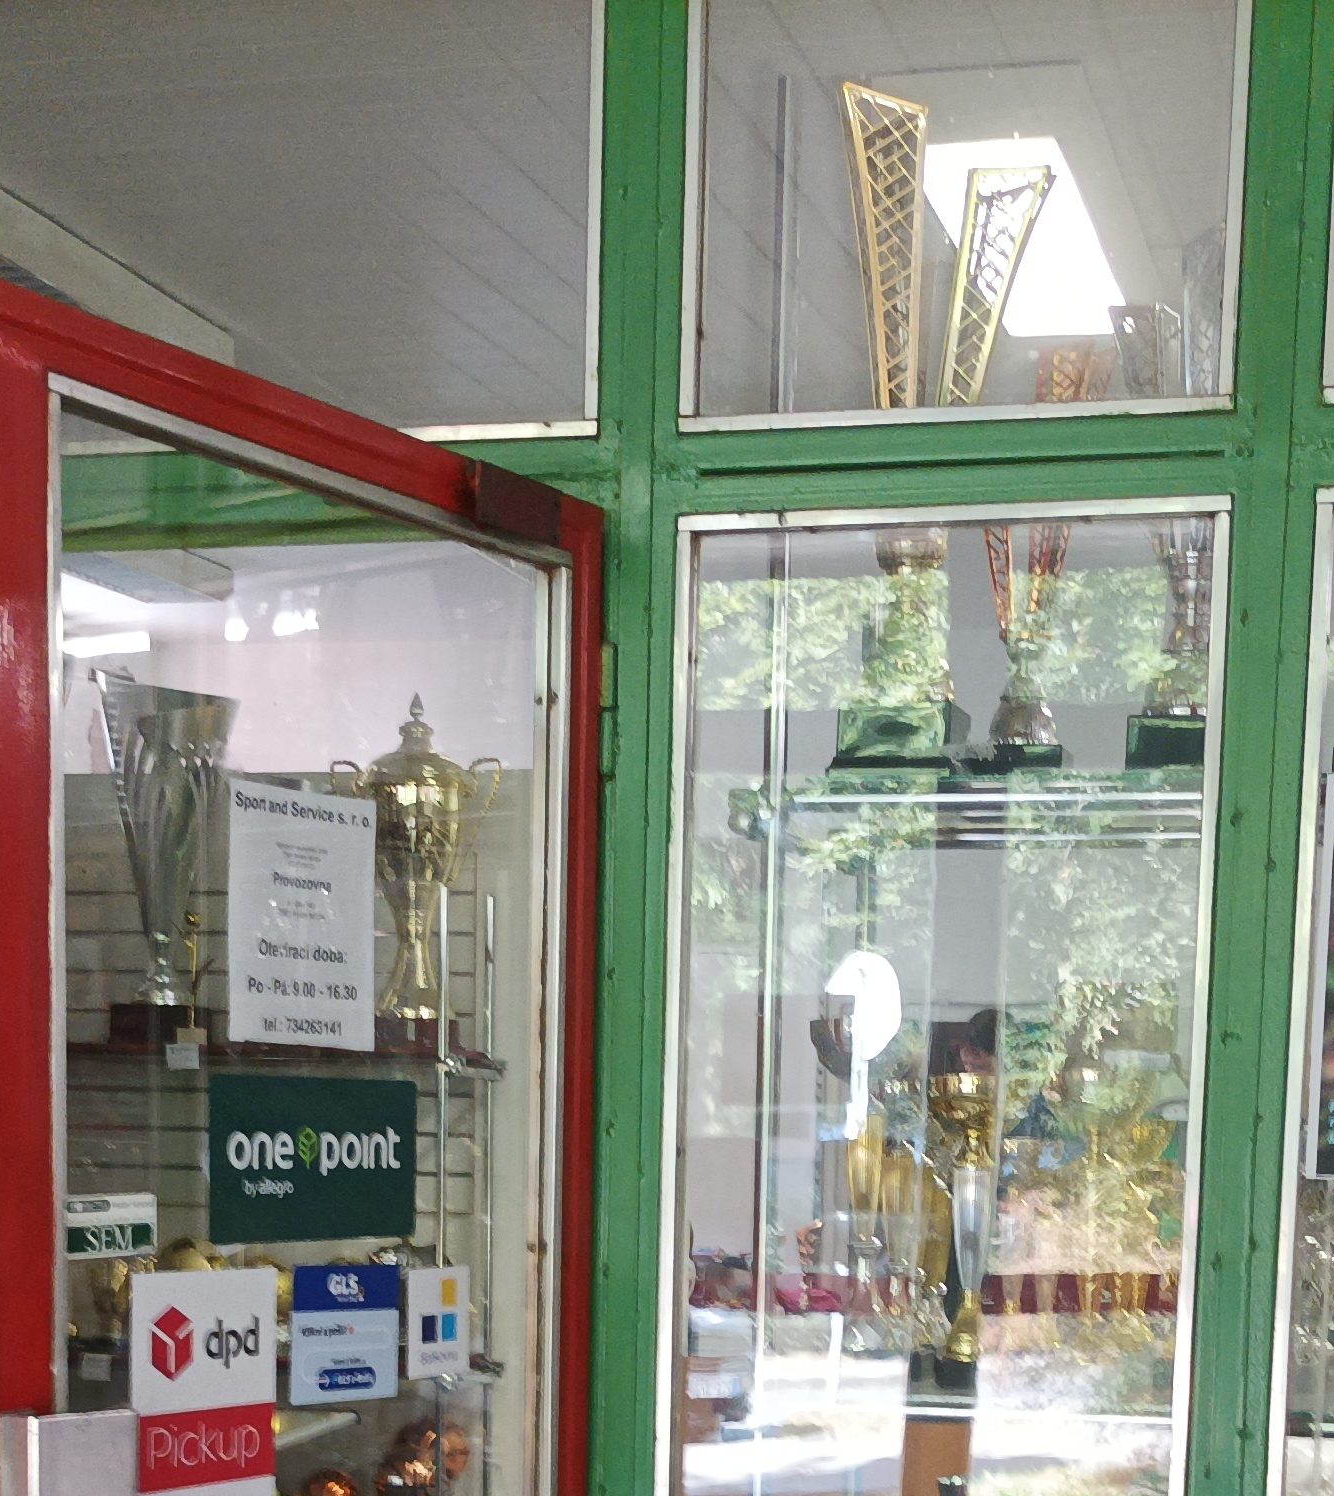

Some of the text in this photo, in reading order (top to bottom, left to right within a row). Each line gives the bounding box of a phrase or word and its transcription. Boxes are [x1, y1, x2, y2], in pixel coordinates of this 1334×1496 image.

[268, 800, 287, 815] and
[291, 801, 335, 823] Service
[273, 871, 332, 892] Provozovna
[247, 976, 264, 994] Po
[326, 983, 358, 1001] 16.30
[226, 1125, 401, 1177] one point
[84, 1224, 135, 1254] SEM
[326, 1272, 359, 1296] GLS
[204, 1314, 260, 1369] dpd
[146, 1420, 261, 1471] Pickup
